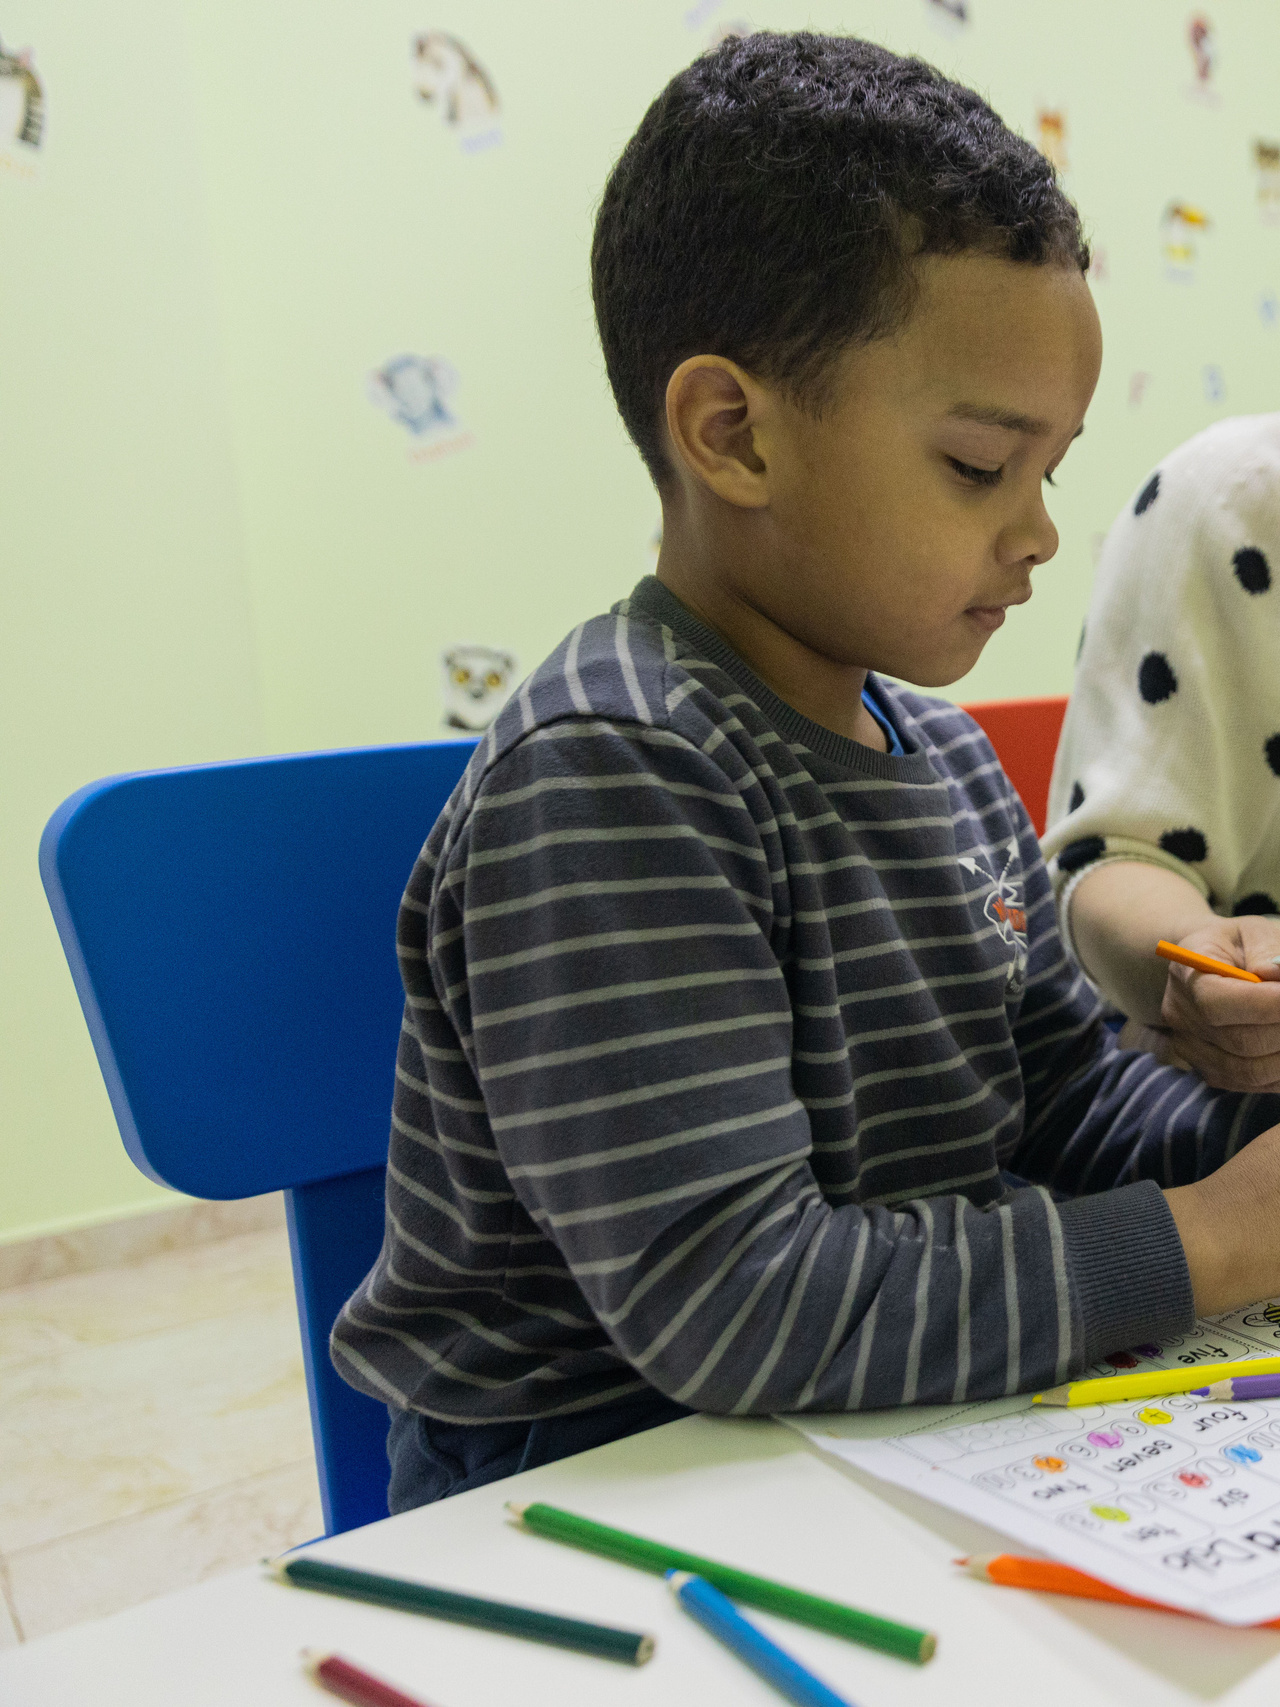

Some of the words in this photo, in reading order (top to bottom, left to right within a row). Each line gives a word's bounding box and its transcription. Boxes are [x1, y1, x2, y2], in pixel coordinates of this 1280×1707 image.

[1177, 1343, 1228, 1359] five
[1193, 1406, 1247, 1432] four
[1103, 1438, 1172, 1474] seven
